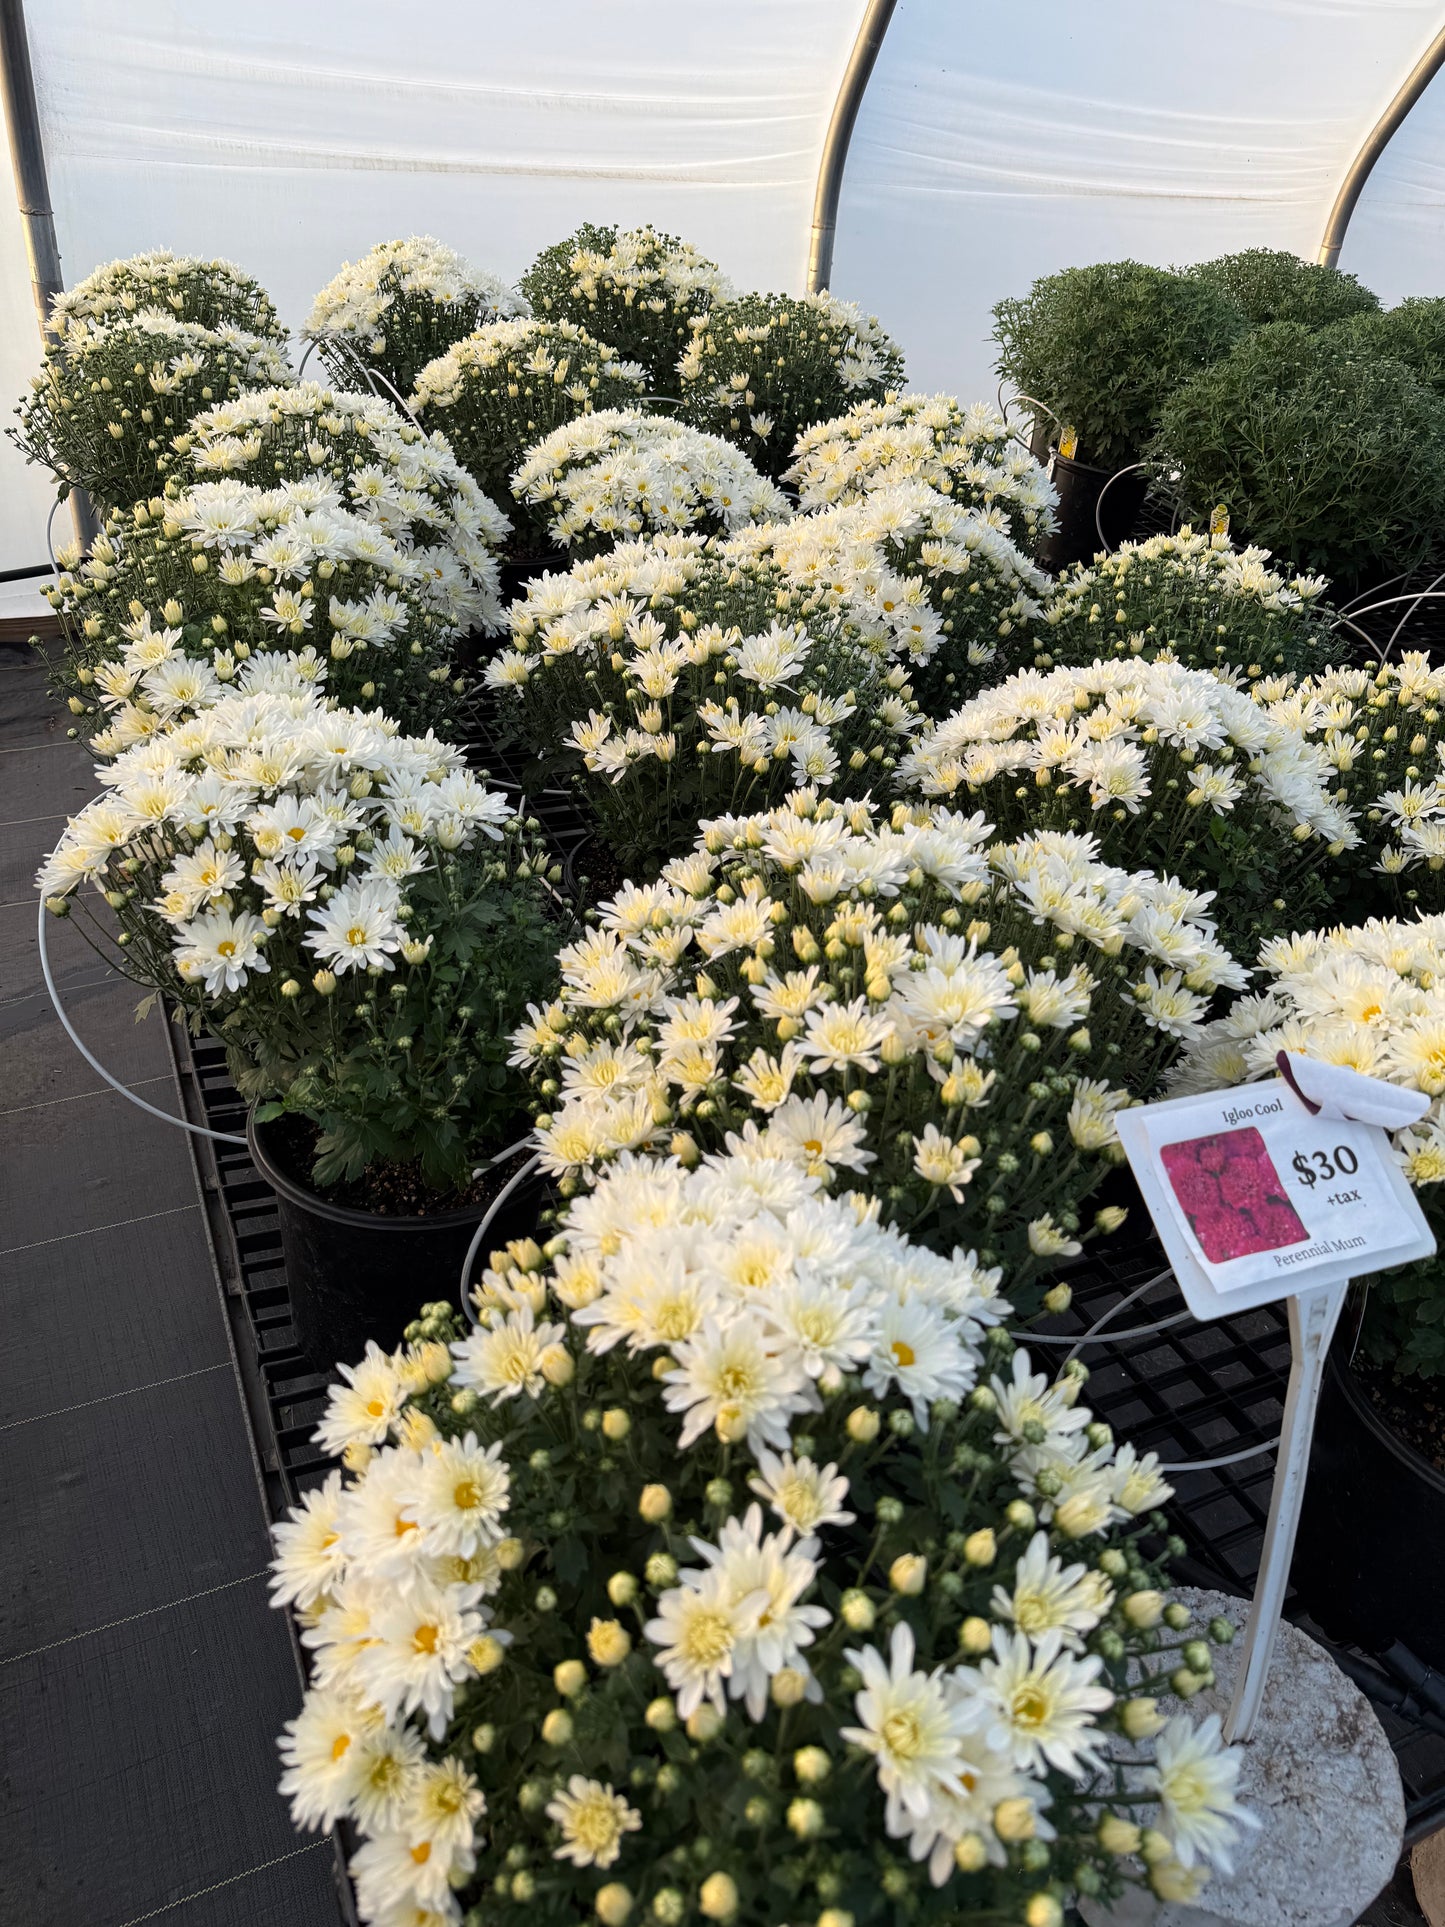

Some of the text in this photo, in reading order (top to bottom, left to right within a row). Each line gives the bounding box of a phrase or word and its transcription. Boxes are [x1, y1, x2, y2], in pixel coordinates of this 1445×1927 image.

[1222, 1098, 1284, 1126] Igloo Cool
[1292, 1145, 1358, 1189] $30
[1327, 1189, 1362, 1206] +tax
[1273, 1235, 1366, 1267] Perennial Mum
